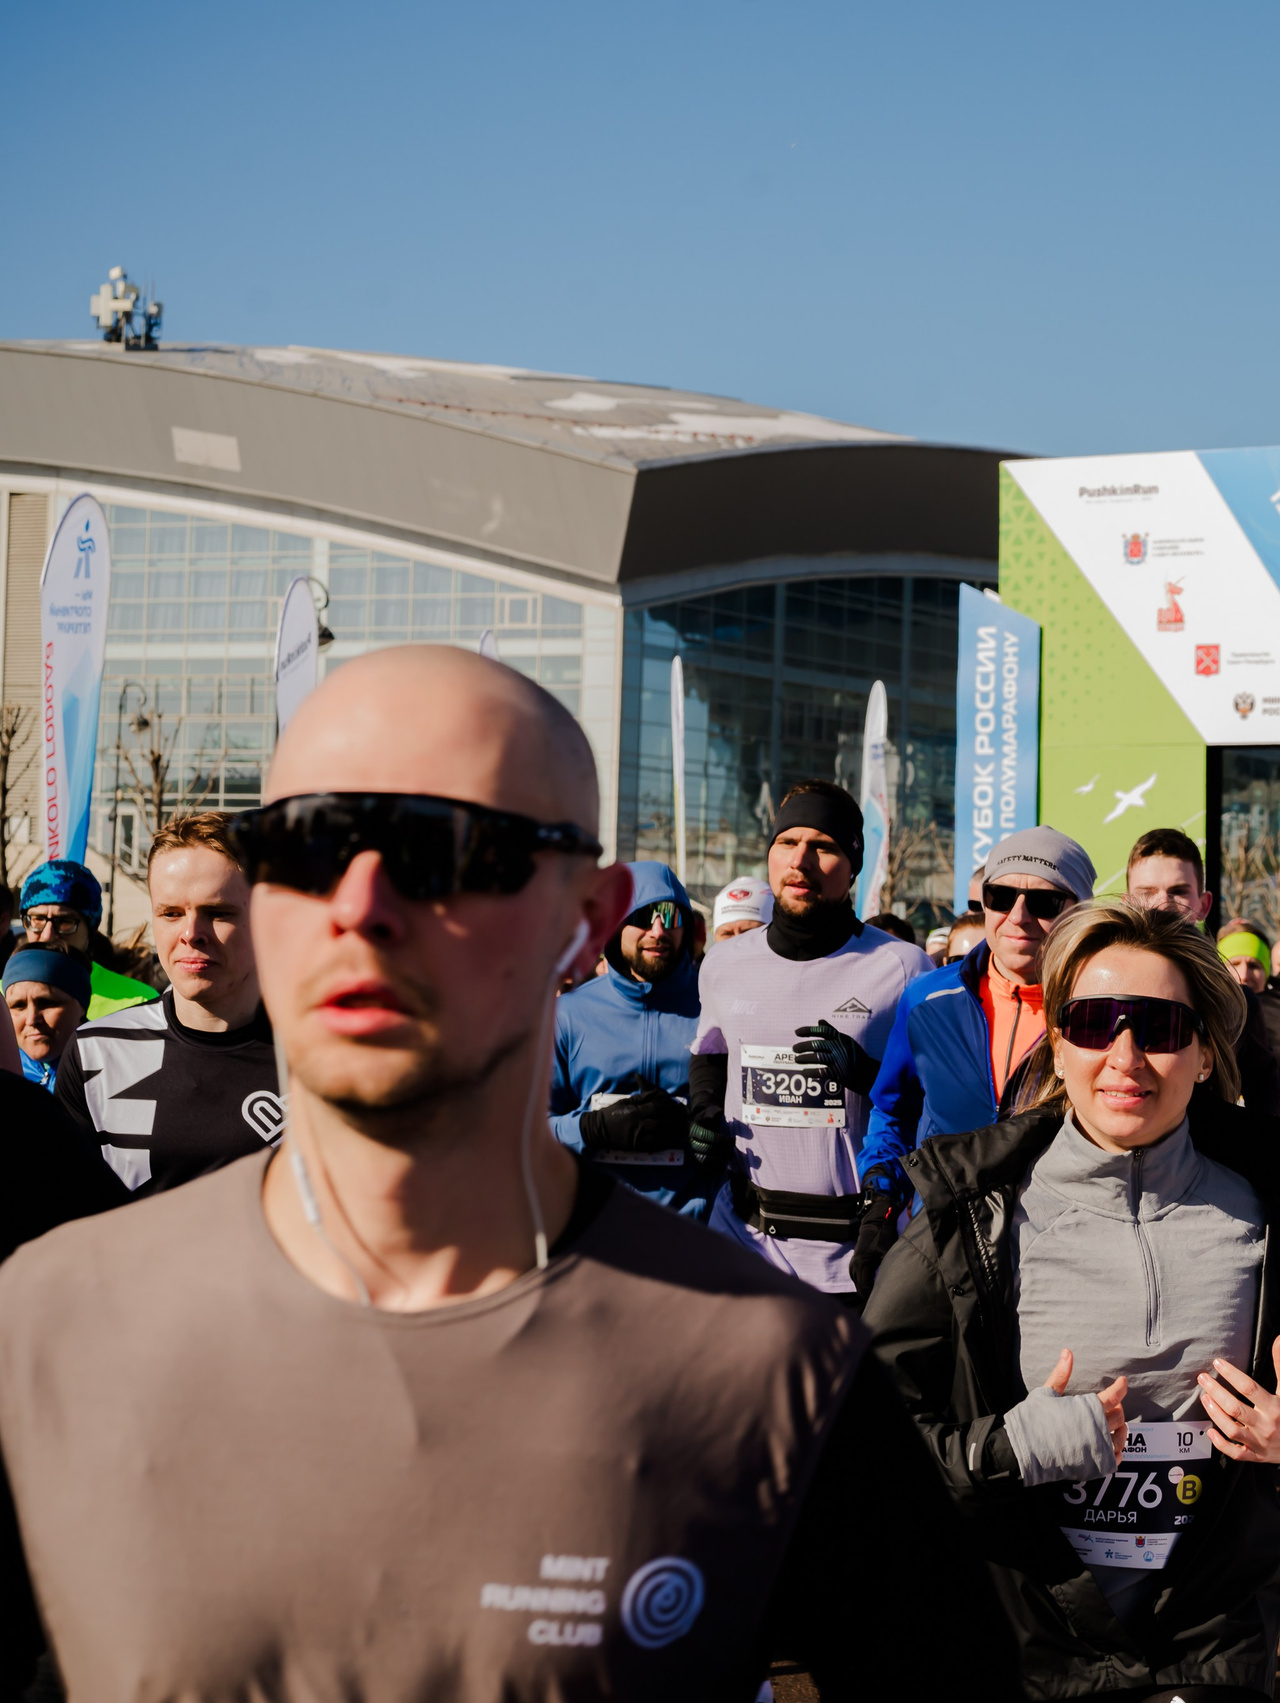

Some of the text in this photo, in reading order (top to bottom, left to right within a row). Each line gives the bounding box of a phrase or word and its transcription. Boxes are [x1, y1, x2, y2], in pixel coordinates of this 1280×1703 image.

[1000, 631, 1019, 829] ПОЛУМАРАФОНУ
[972, 625, 998, 871] КУБОК РОССИИ
[774, 1053, 797, 1061] АРЕ
[761, 1072, 822, 1097] 3205
[778, 1094, 803, 1104] ИВАН
[1126, 1433, 1147, 1446] НА
[1176, 1431, 1194, 1447] 10
[1063, 1471, 1163, 1509] 3776
[1084, 1508, 1138, 1524] ДАРЬЯ
[1174, 1515, 1195, 1526] 202
[528, 1618, 603, 1647] CLUB
